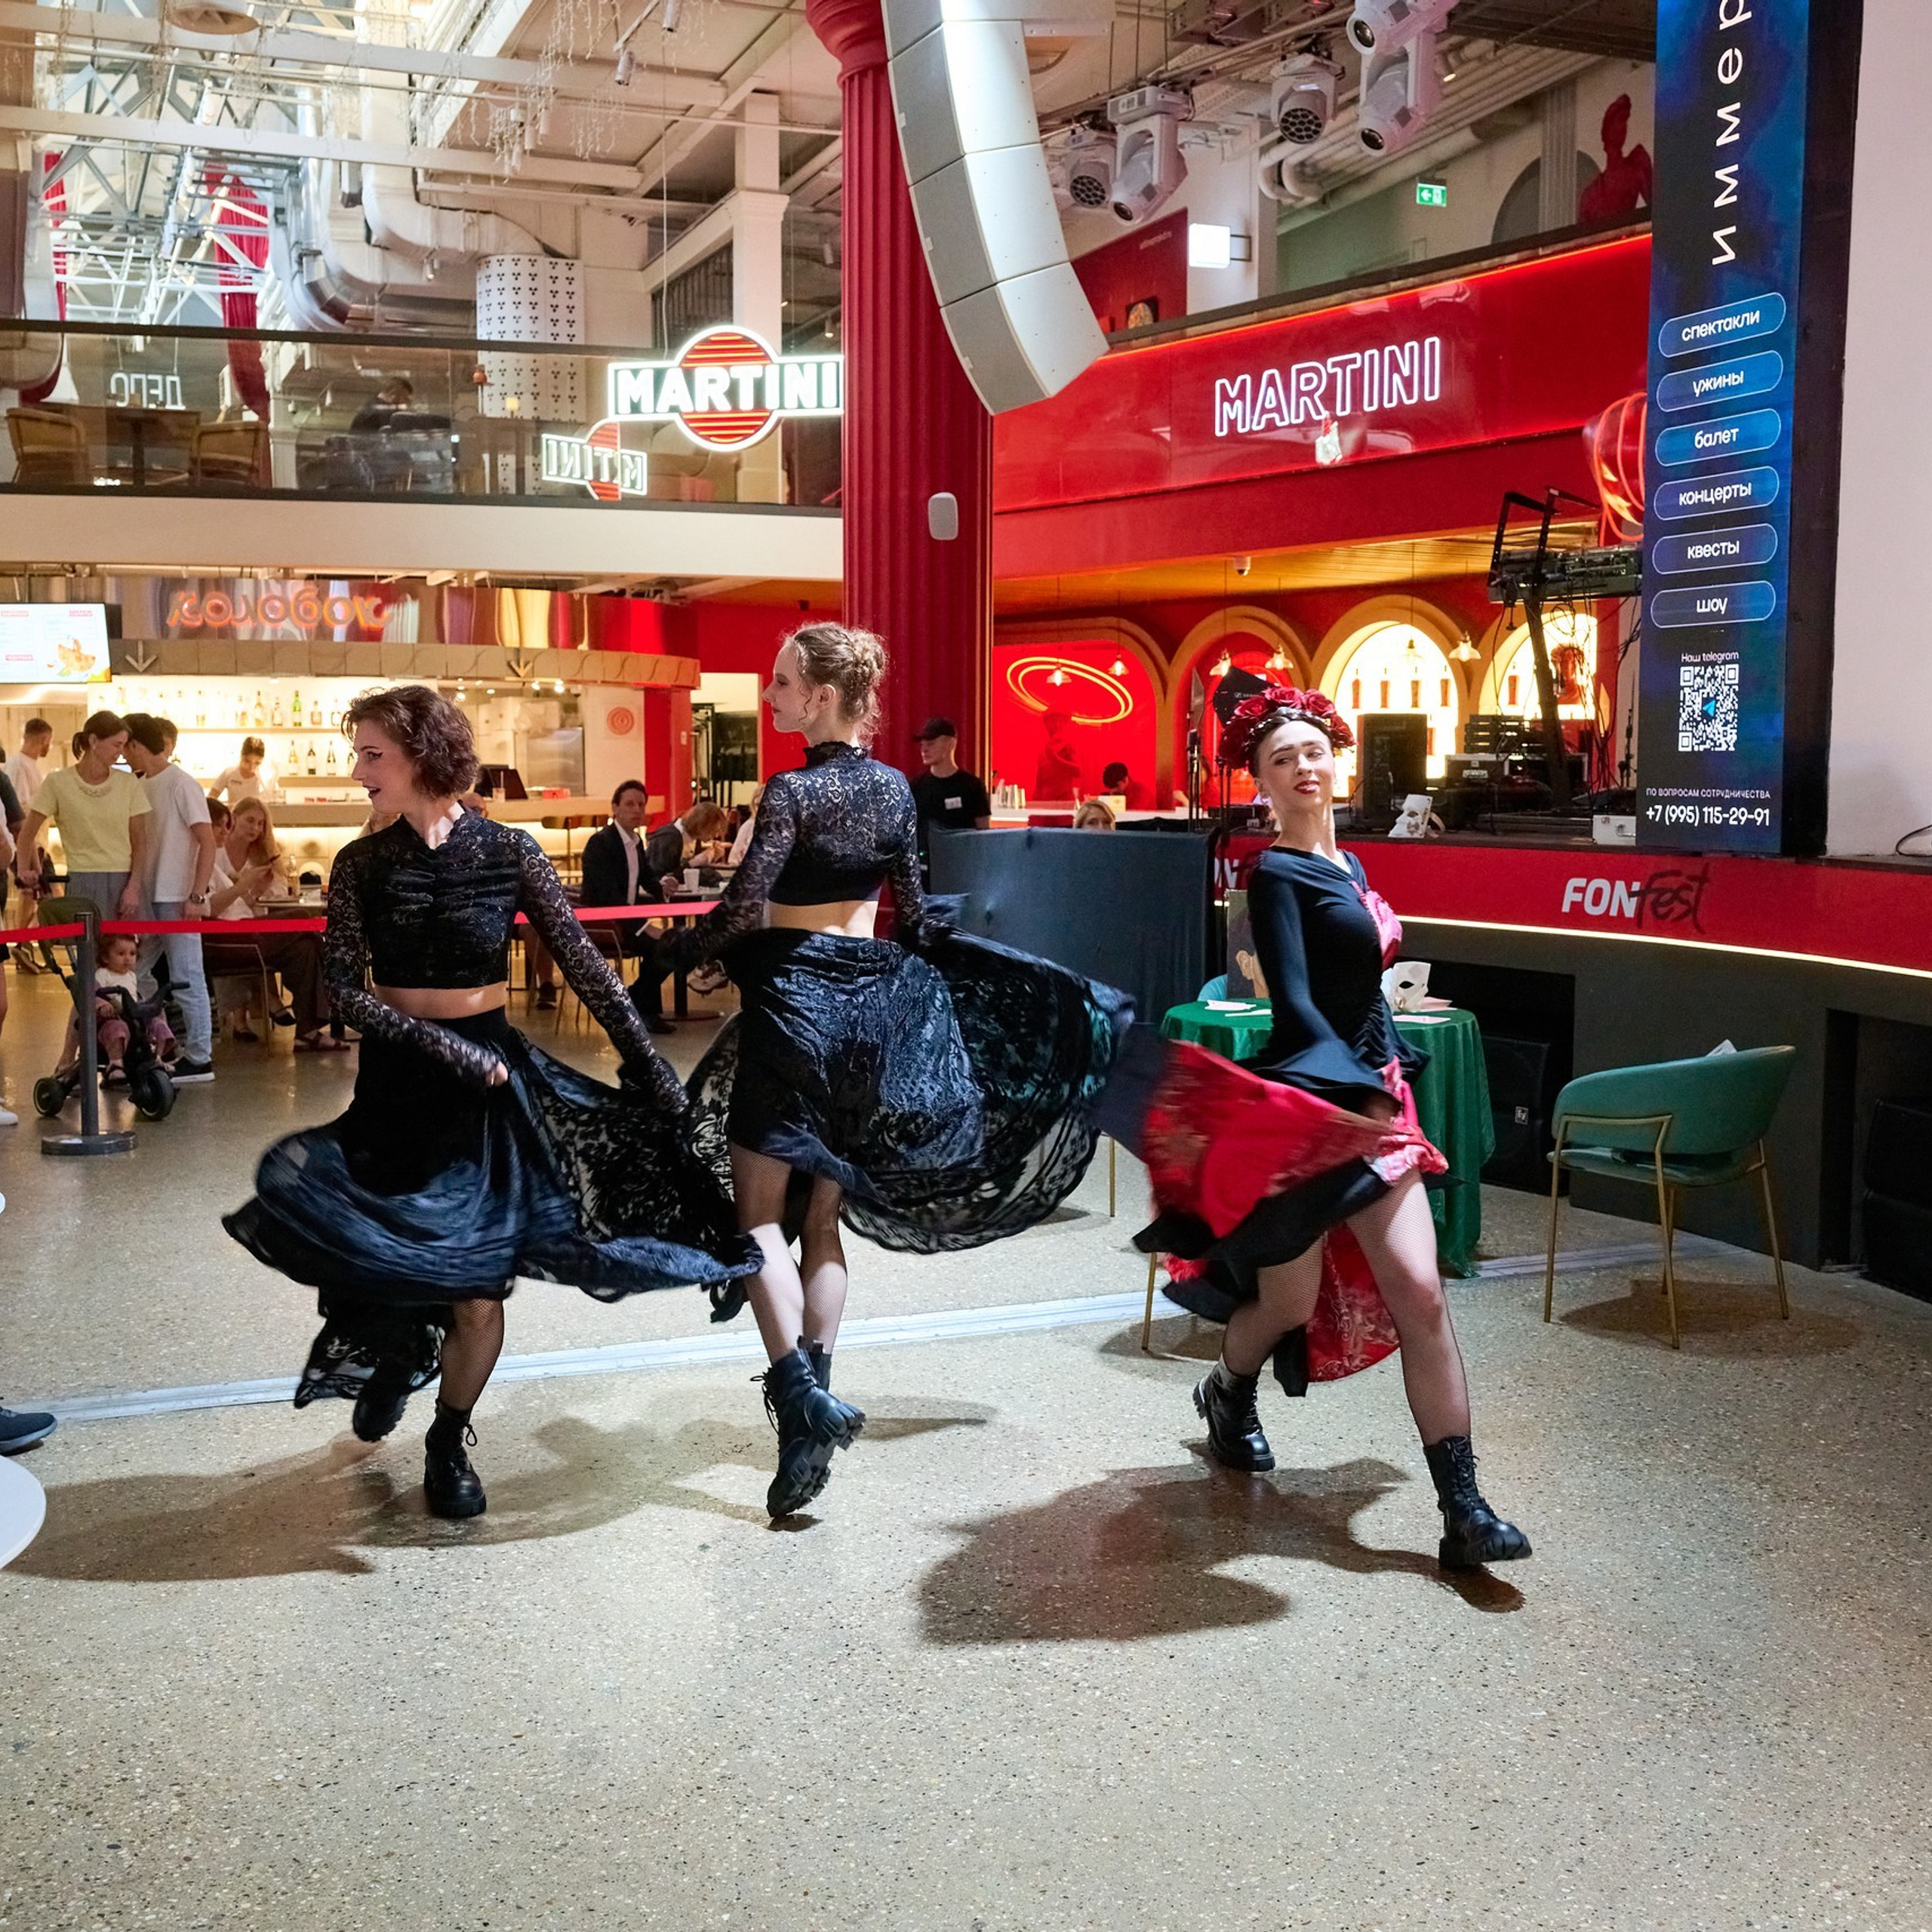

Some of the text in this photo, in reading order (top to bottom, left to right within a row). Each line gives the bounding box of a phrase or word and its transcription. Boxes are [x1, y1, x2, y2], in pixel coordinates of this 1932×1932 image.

[1681, 309, 1760, 342] спектакли
[617, 361, 838, 415] MARTINI
[1214, 336, 1441, 438] MARTINI
[1692, 370, 1744, 397] ужины
[1694, 426, 1740, 449] балет
[1678, 481, 1752, 505] концерты
[1687, 539, 1740, 560] квесты
[1696, 597, 1728, 615] шоу
[1681, 651, 1740, 664] Наш telegram
[1646, 787, 1771, 799] ПО ВОПРОСАМ СОТРУДНИЧЕСТВА
[1645, 804, 1770, 827] +7 (995) 115-29-91
